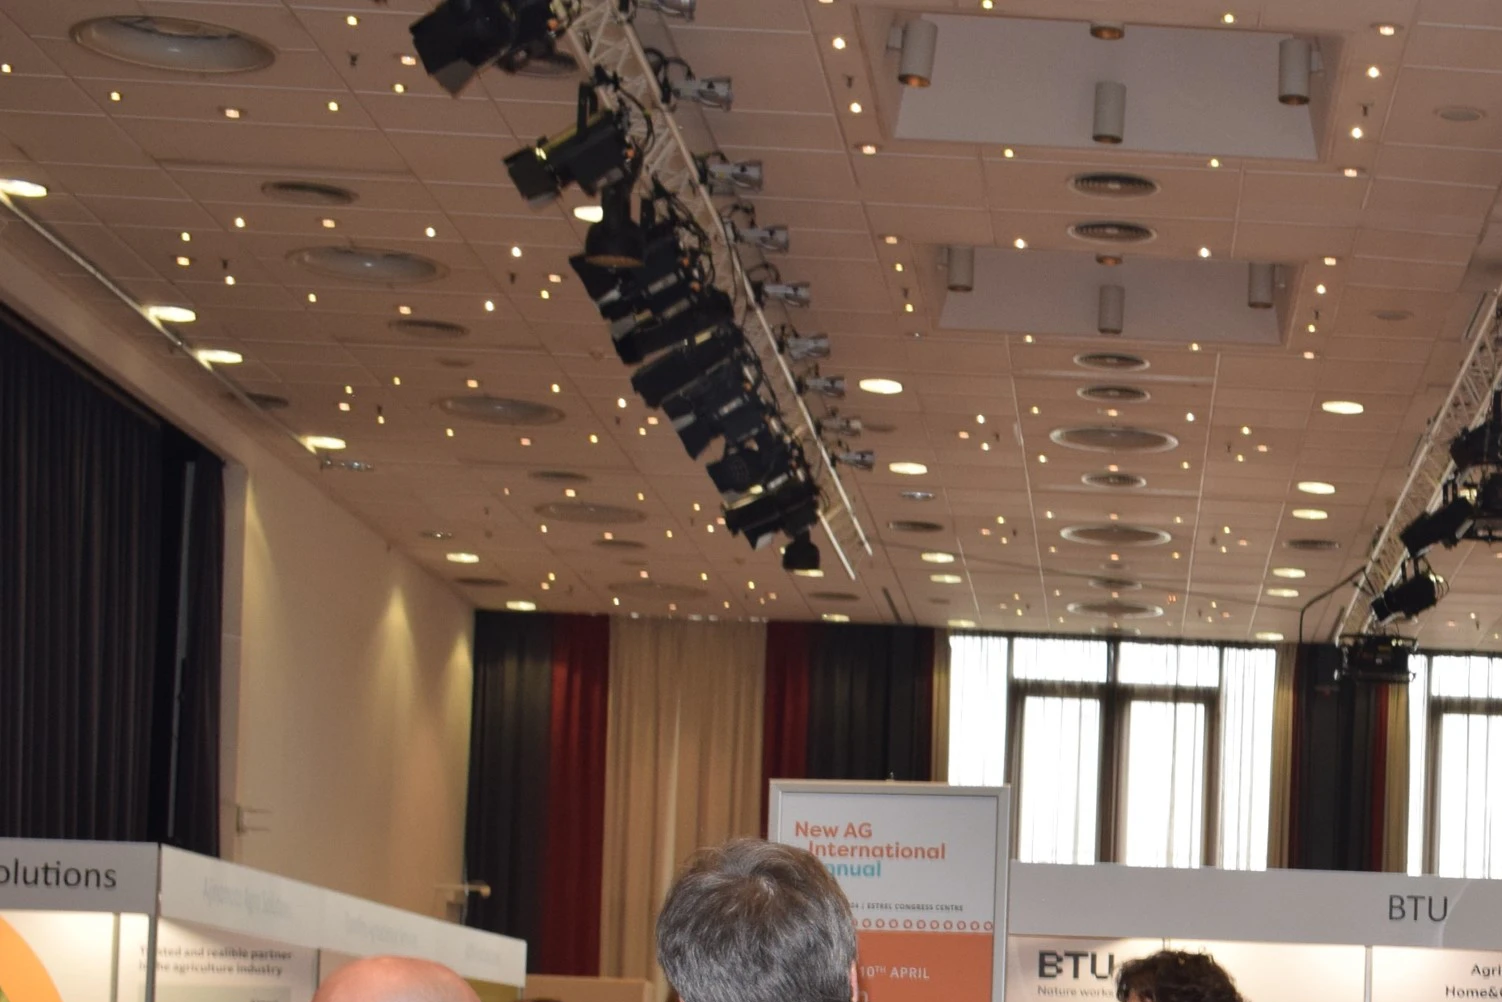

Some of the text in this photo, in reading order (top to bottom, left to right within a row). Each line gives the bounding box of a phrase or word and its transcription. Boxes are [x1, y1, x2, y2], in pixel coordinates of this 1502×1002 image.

[795, 821, 873, 838] New AG
[809, 841, 946, 860] International
[0, 857, 117, 889] olutions
[824, 861, 881, 877] nnual
[1389, 895, 1448, 922] BTU
[890, 967, 929, 979] APRIL
[1038, 950, 1115, 979] BTU
